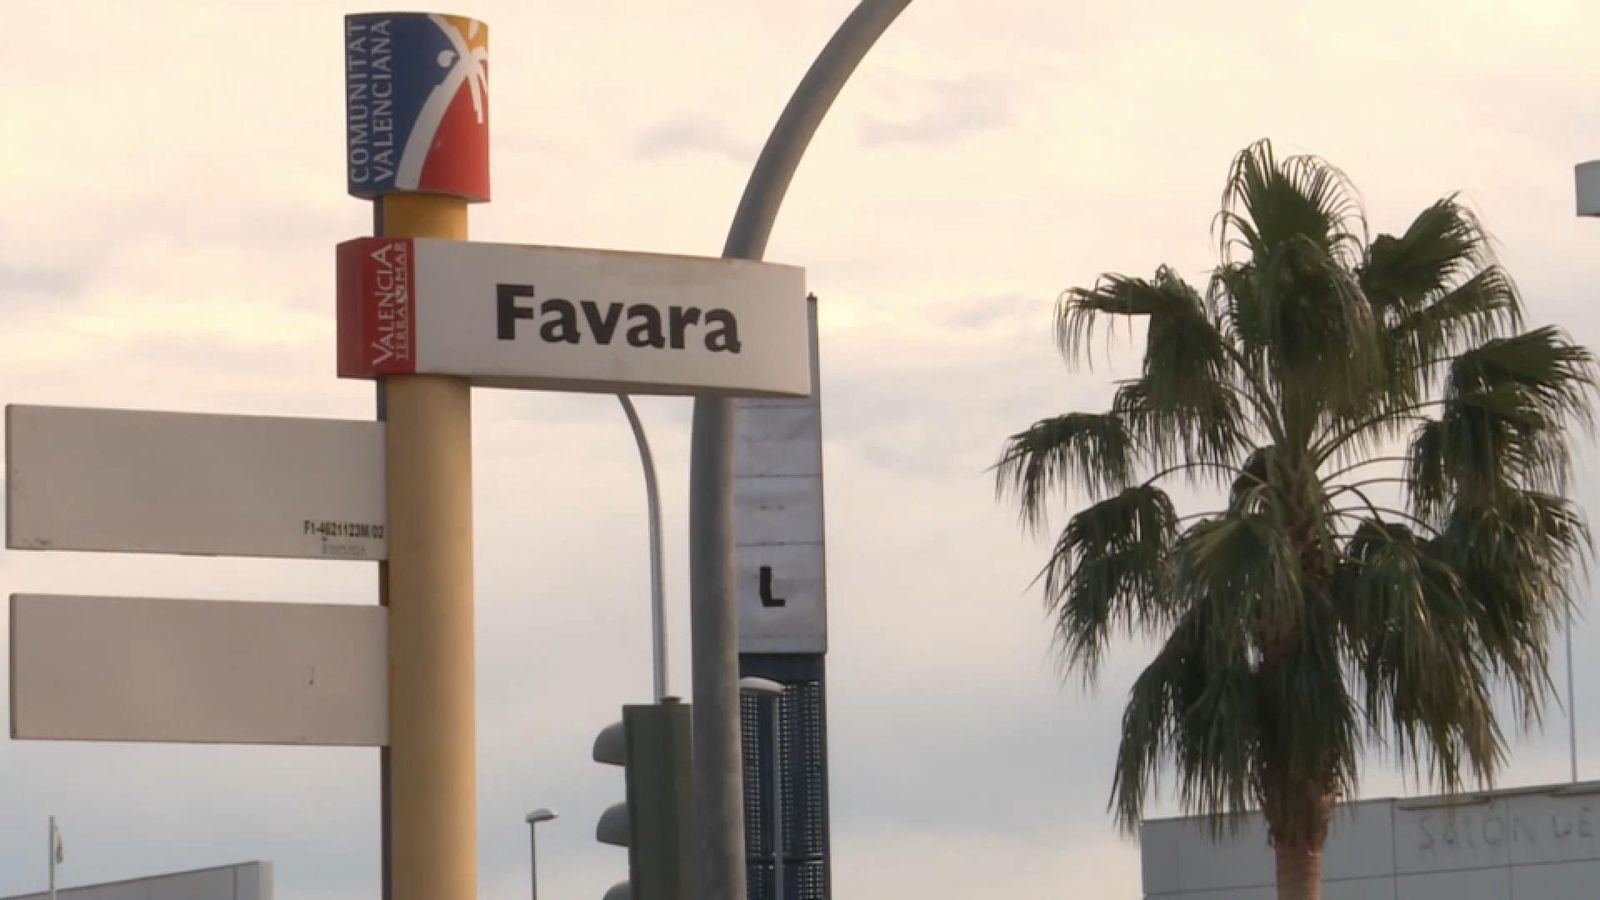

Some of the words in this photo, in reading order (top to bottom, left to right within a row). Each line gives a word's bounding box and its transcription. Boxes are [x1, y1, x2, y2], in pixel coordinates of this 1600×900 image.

[348, 20, 369, 183] COMUNITAT
[371, 19, 394, 182] VALENCIANA
[370, 243, 395, 366] VALENCIA
[495, 283, 742, 354] Favara
[760, 566, 786, 607] L
